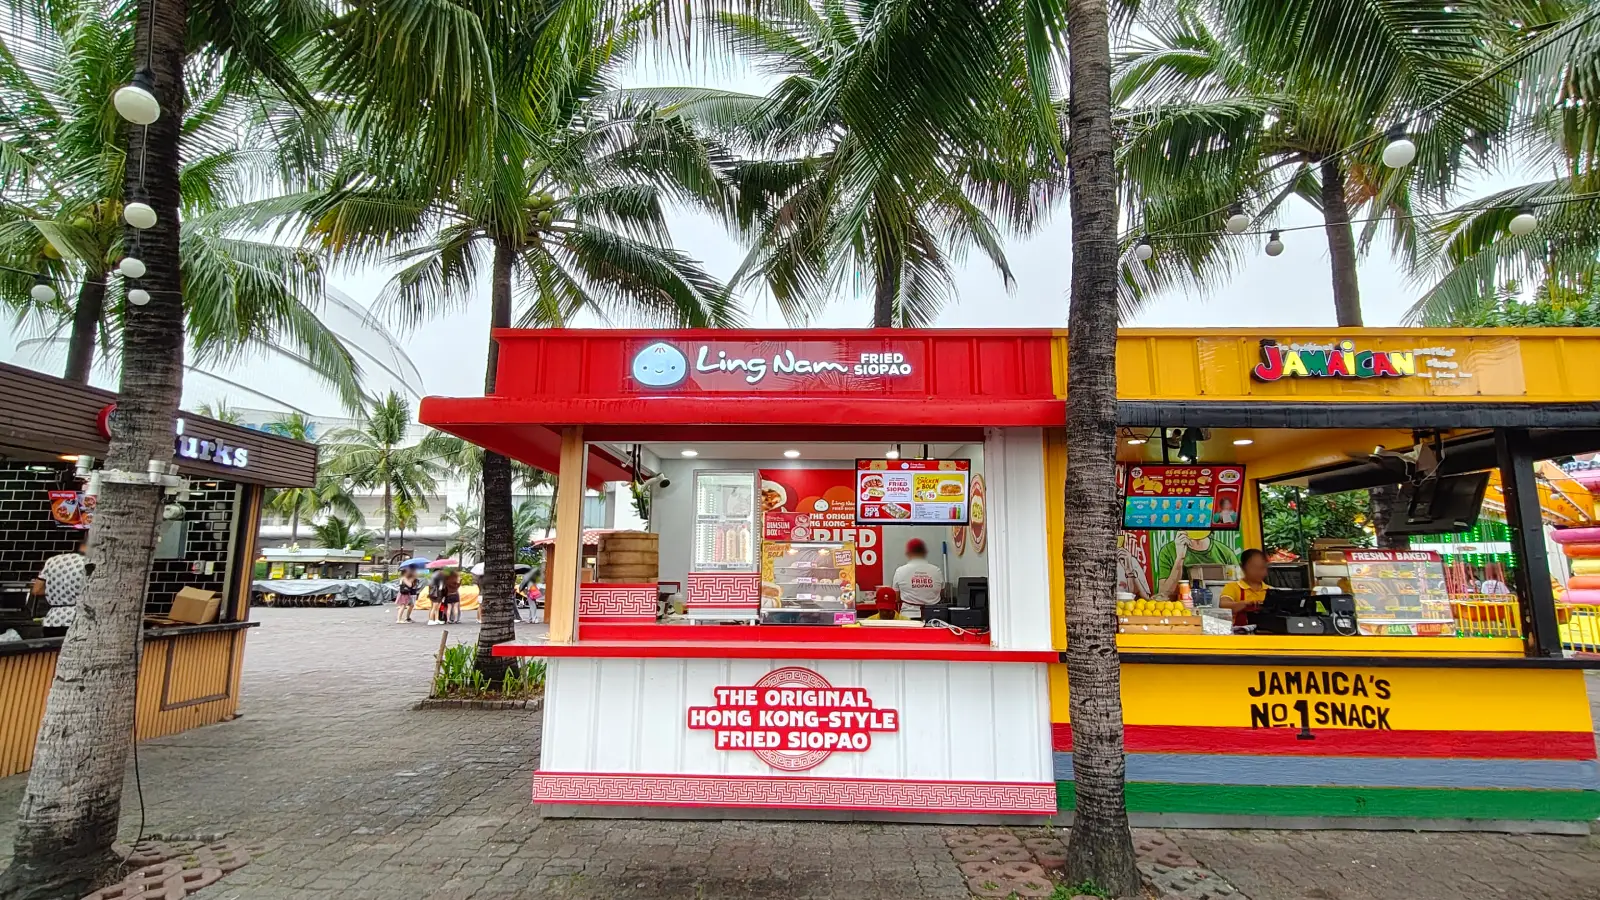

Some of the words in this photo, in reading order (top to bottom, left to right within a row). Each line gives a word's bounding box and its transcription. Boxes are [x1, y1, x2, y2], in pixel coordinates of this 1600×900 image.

[697, 345, 767, 382] Ling
[773, 350, 848, 374] Nam
[860, 353, 904, 364] FRIED
[853, 364, 912, 376] SIOPAO
[173, 420, 248, 468] urks
[811, 529, 877, 547] RIED
[1351, 552, 1393, 561] FRESHLY
[1248, 671, 1391, 700] JAMAICA'S
[717, 690, 758, 706] THE
[765, 690, 869, 707] ORIGINAL
[691, 710, 751, 727] HONG
[759, 710, 896, 729] KONG-STYLE
[1315, 701, 1391, 731] SNACK
[717, 731, 781, 748] FRIED
[787, 732, 868, 749] SIOPAO
